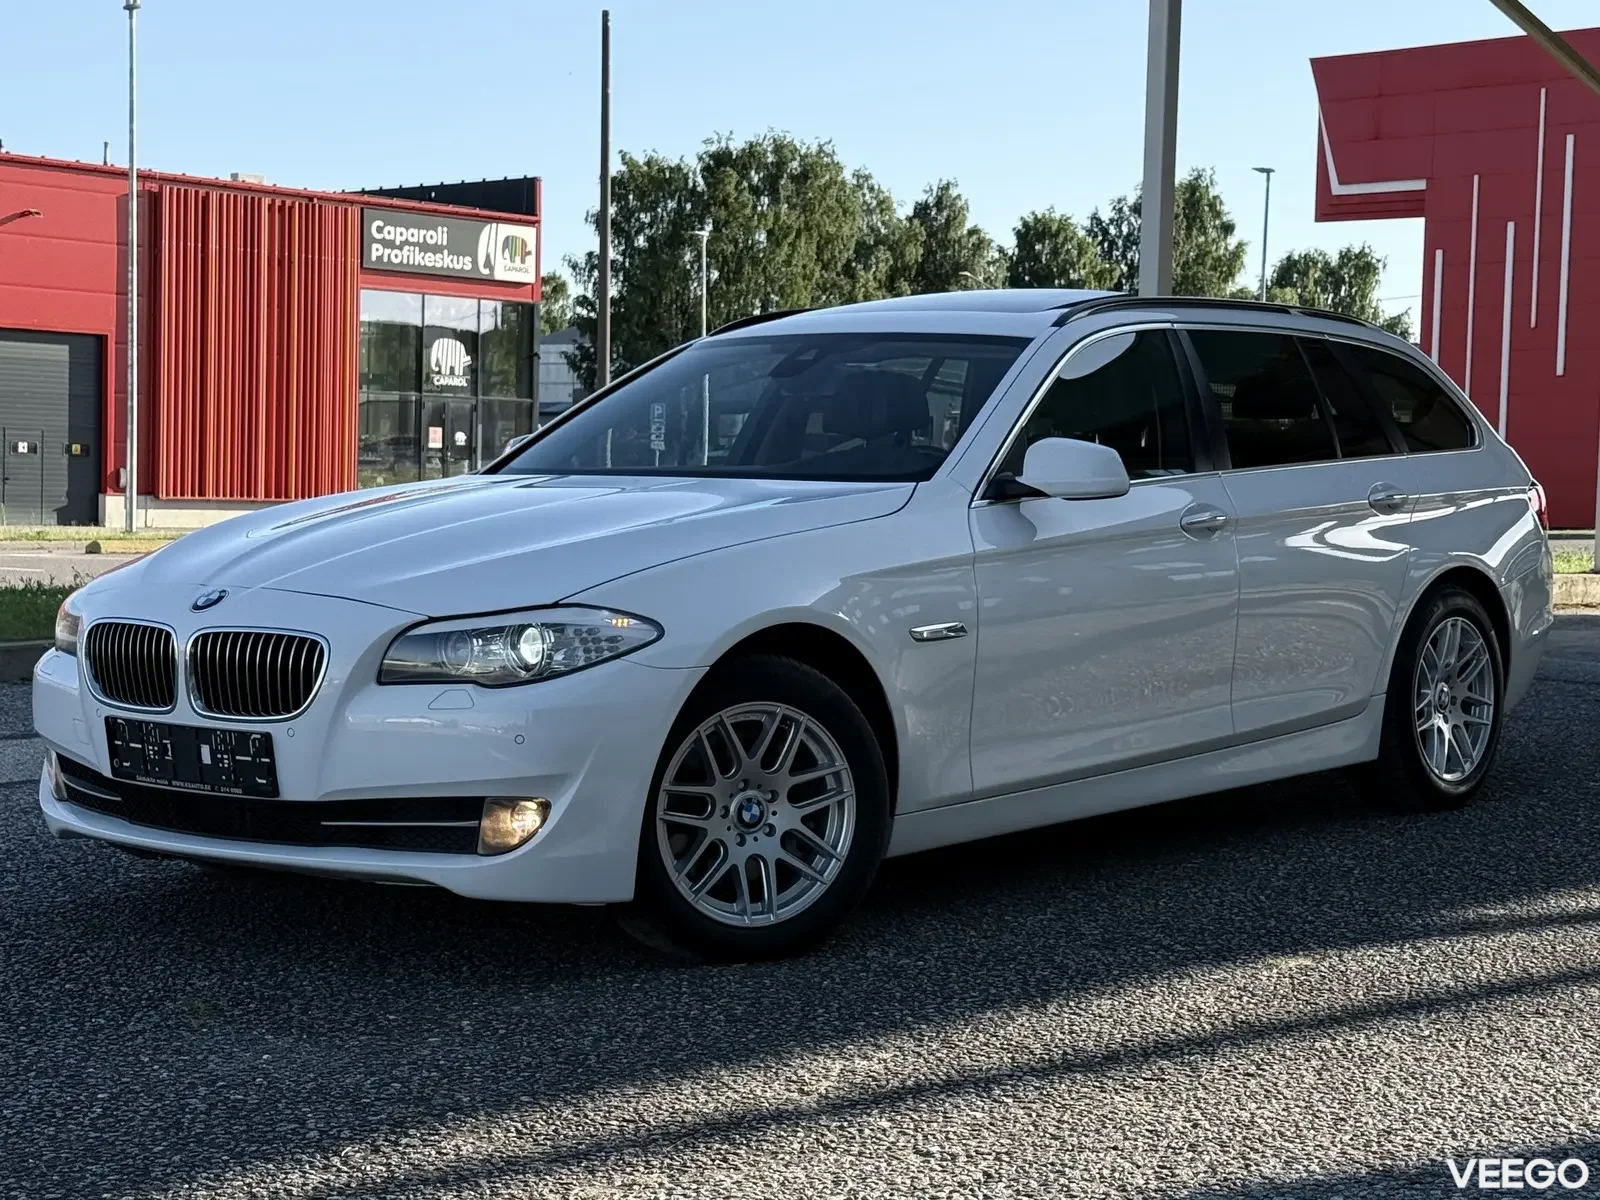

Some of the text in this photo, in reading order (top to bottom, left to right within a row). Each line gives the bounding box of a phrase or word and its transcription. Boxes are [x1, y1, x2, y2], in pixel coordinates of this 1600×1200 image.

[371, 220, 448, 246] Caparoli
[371, 243, 473, 271] Profikeskus
[503, 265, 532, 275] CAPAROL
[433, 375, 468, 387] CAPAROL
